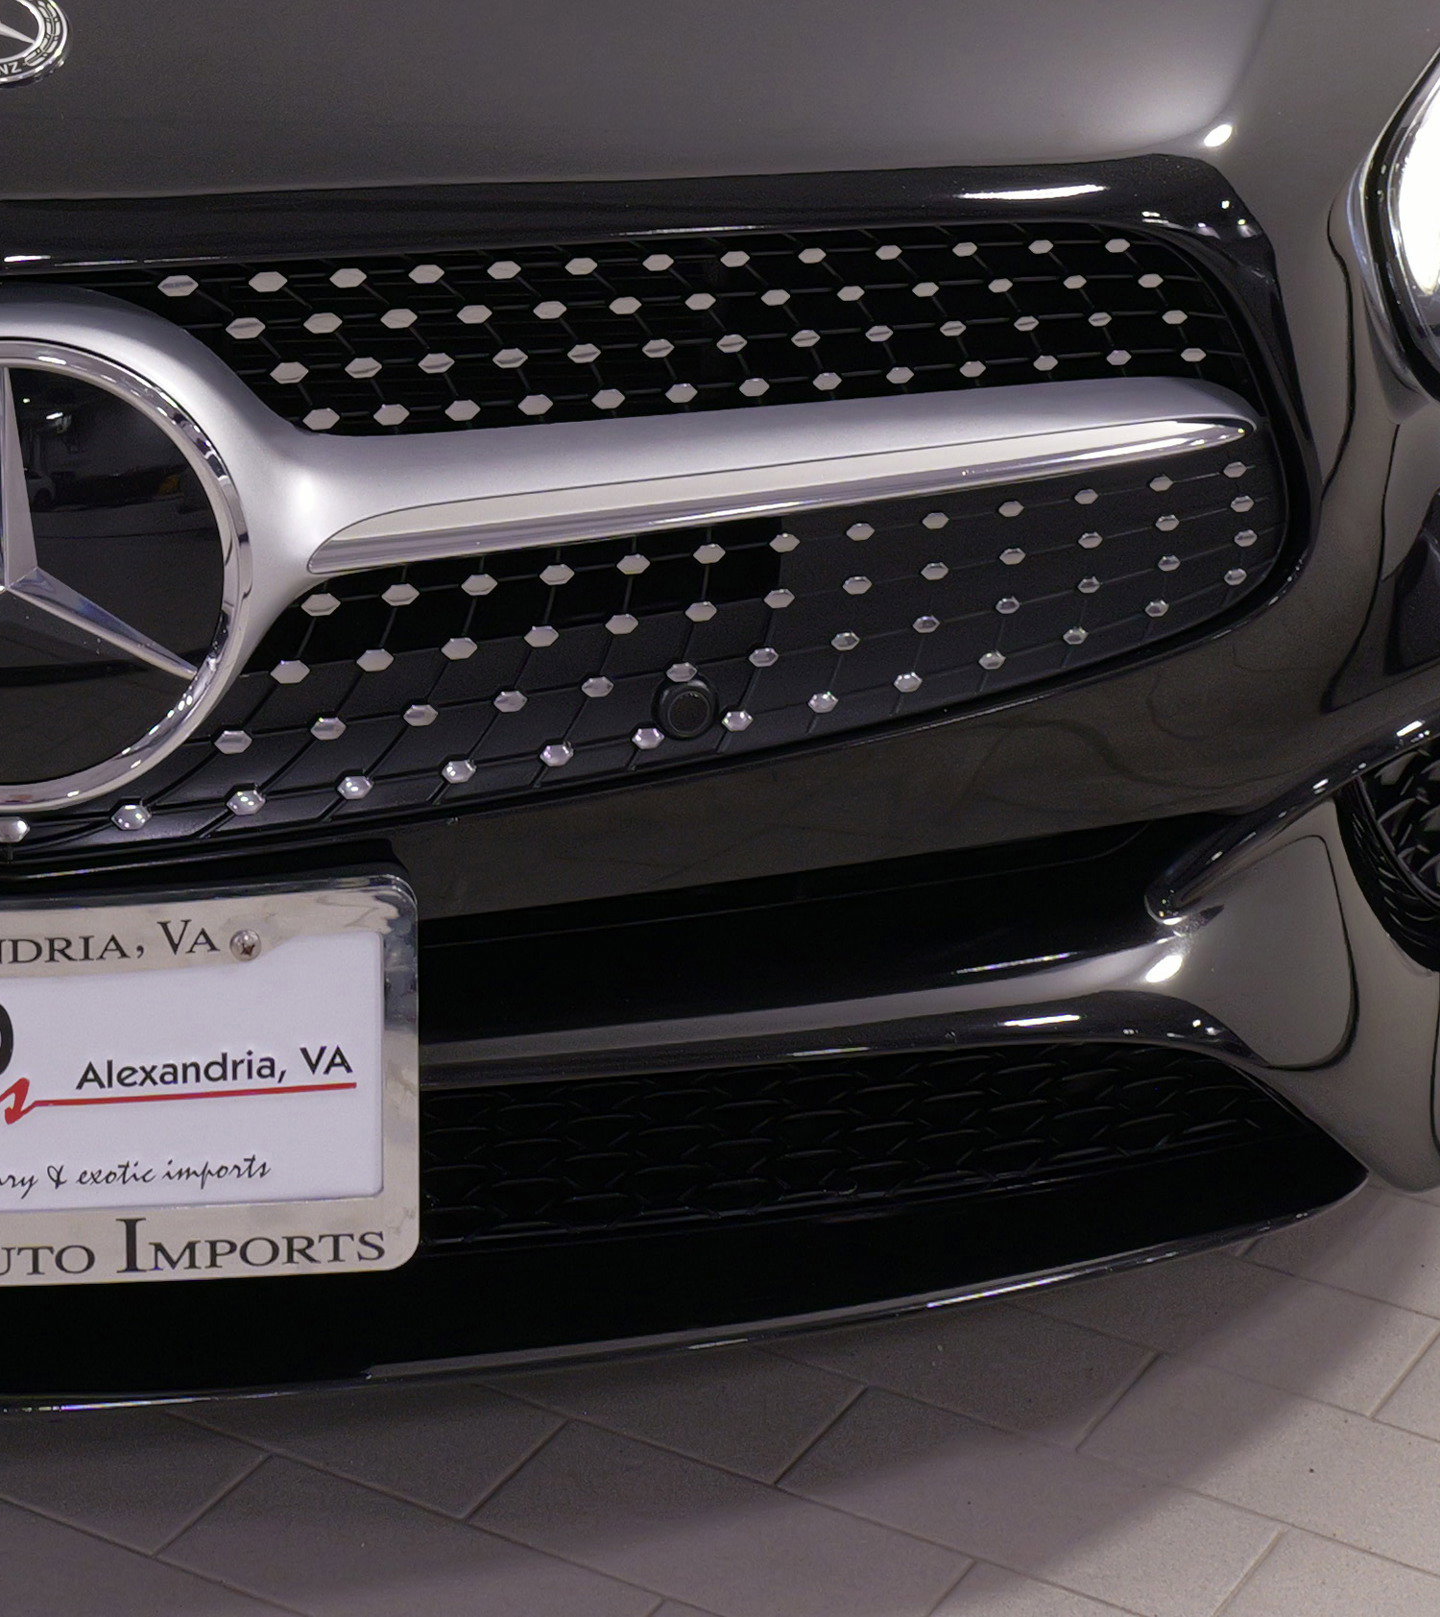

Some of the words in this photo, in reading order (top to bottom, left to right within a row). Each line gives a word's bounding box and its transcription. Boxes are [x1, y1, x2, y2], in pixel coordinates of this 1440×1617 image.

[75, 1050, 287, 1090] Alexandria,
[300, 1045, 353, 1076] VA
[47, 1165, 67, 1190] &
[76, 1160, 156, 1185] exotic
[162, 1154, 272, 1190] imports
[115, 1217, 386, 1273] IMPORTS
